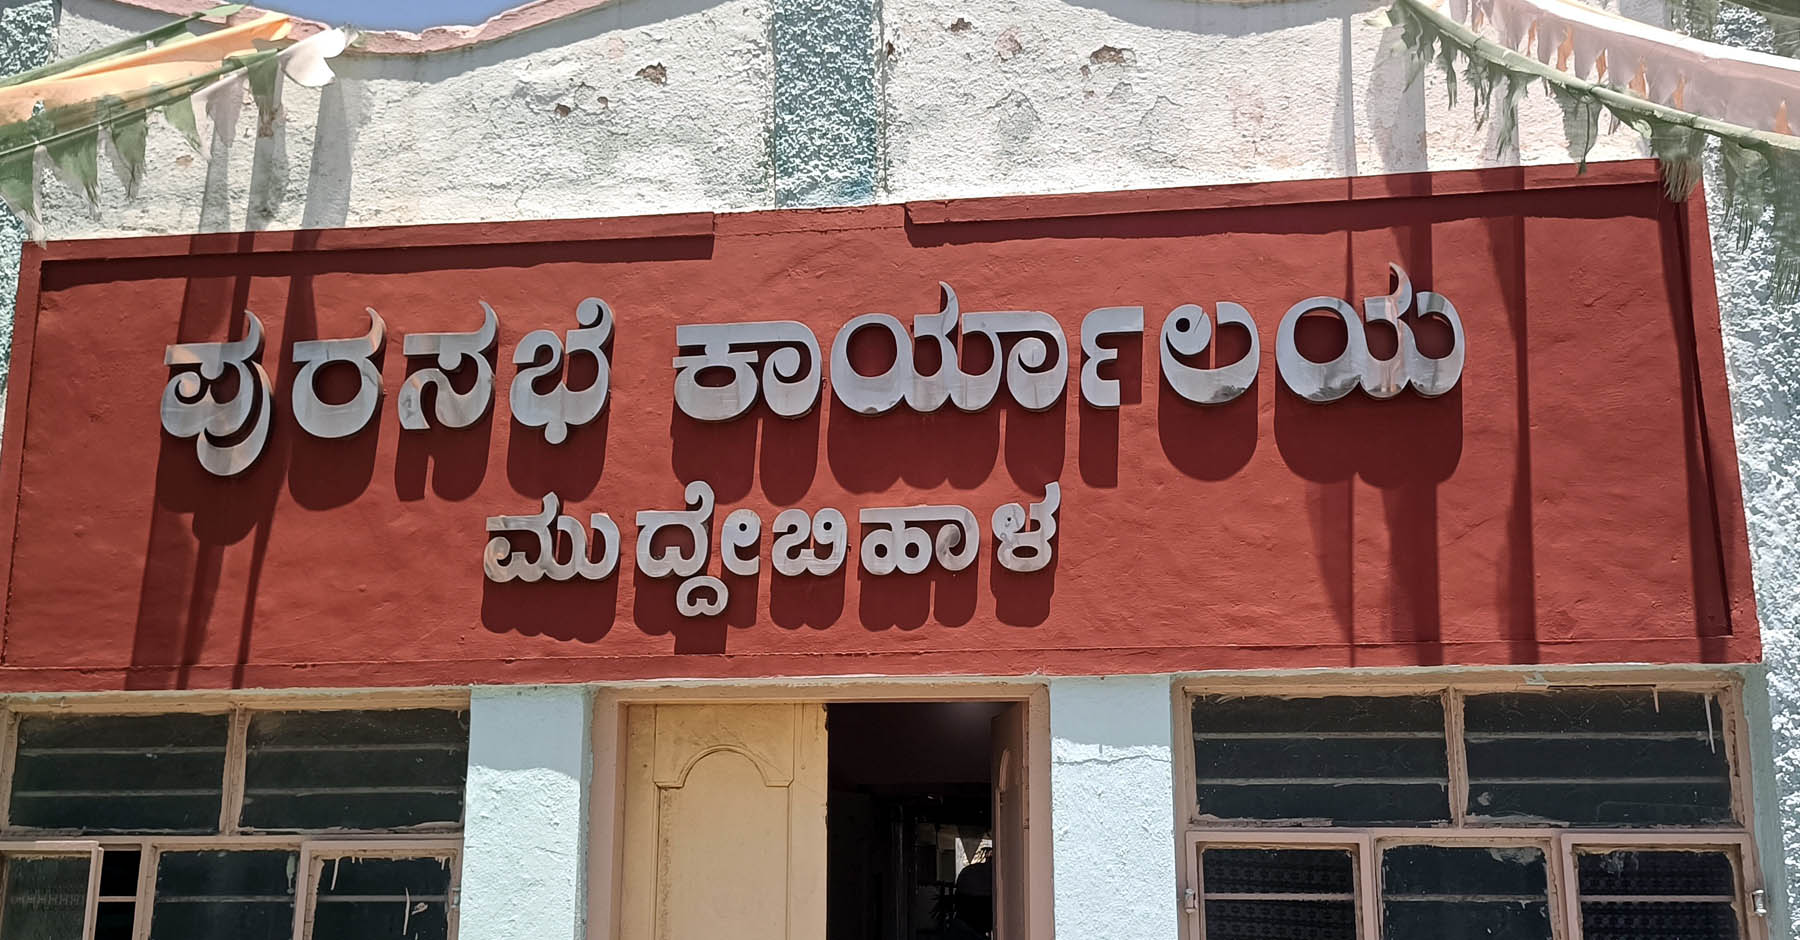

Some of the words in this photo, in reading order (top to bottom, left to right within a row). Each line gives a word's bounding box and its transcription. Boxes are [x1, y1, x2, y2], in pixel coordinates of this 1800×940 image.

[160, 297, 615, 475] ಪುರಸಭೆ
[672, 262, 1466, 421] ಕಾರ್ಯಾಲಯ
[483, 480, 1061, 617] ಮುದ್ದೇಬಿಹಾಳ
